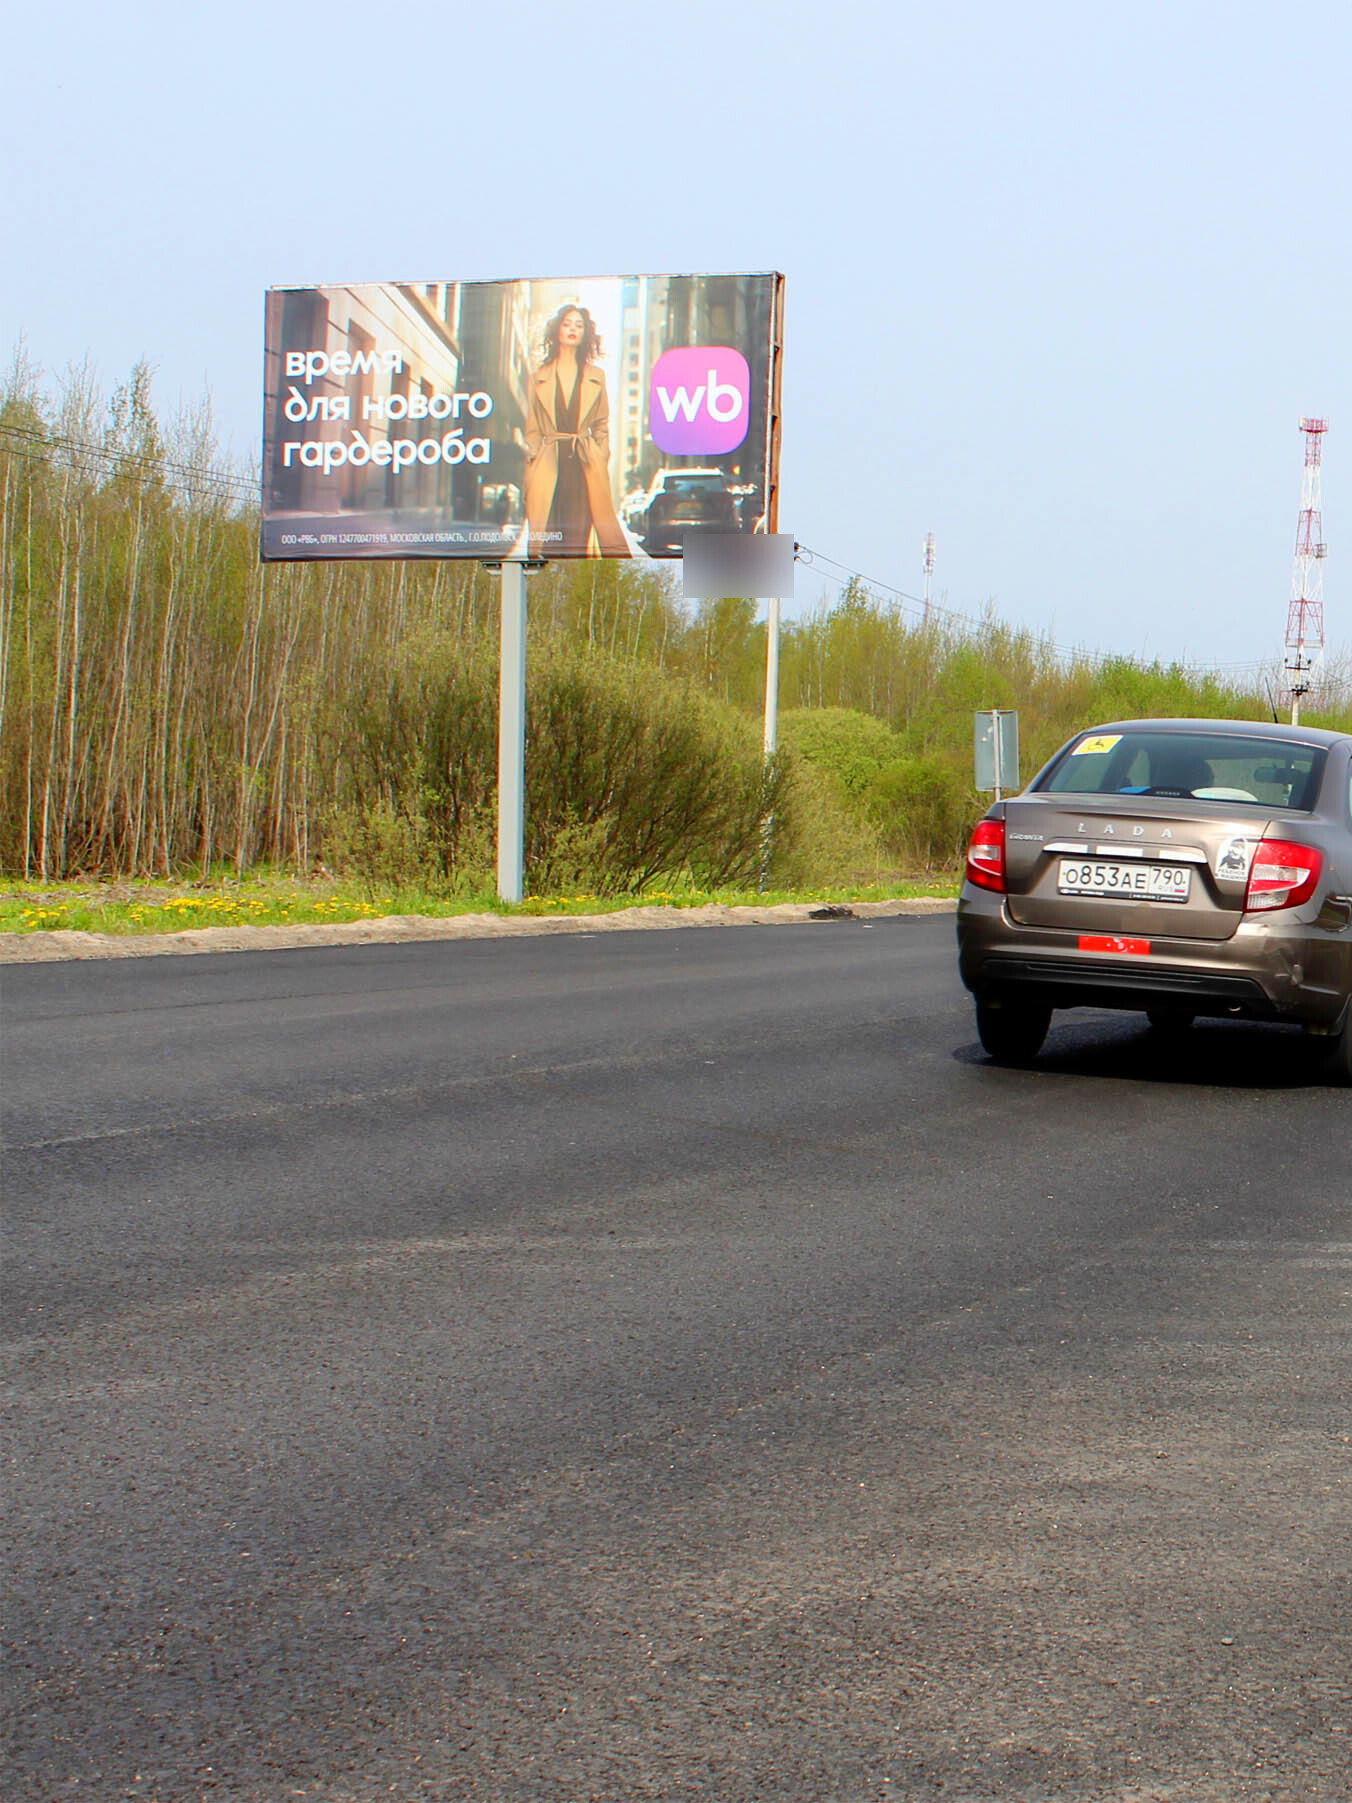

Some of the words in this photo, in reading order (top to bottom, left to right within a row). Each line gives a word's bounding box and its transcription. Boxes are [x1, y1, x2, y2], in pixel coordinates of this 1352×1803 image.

[285, 349, 403, 385] время
[284, 386, 350, 422] для
[362, 391, 493, 420] нового
[656, 369, 742, 422] wb
[282, 428, 491, 475] гардероба
[281, 534, 297, 544] ООО
[1078, 823, 1173, 838] LADA
[1153, 868, 1183, 886] 790
